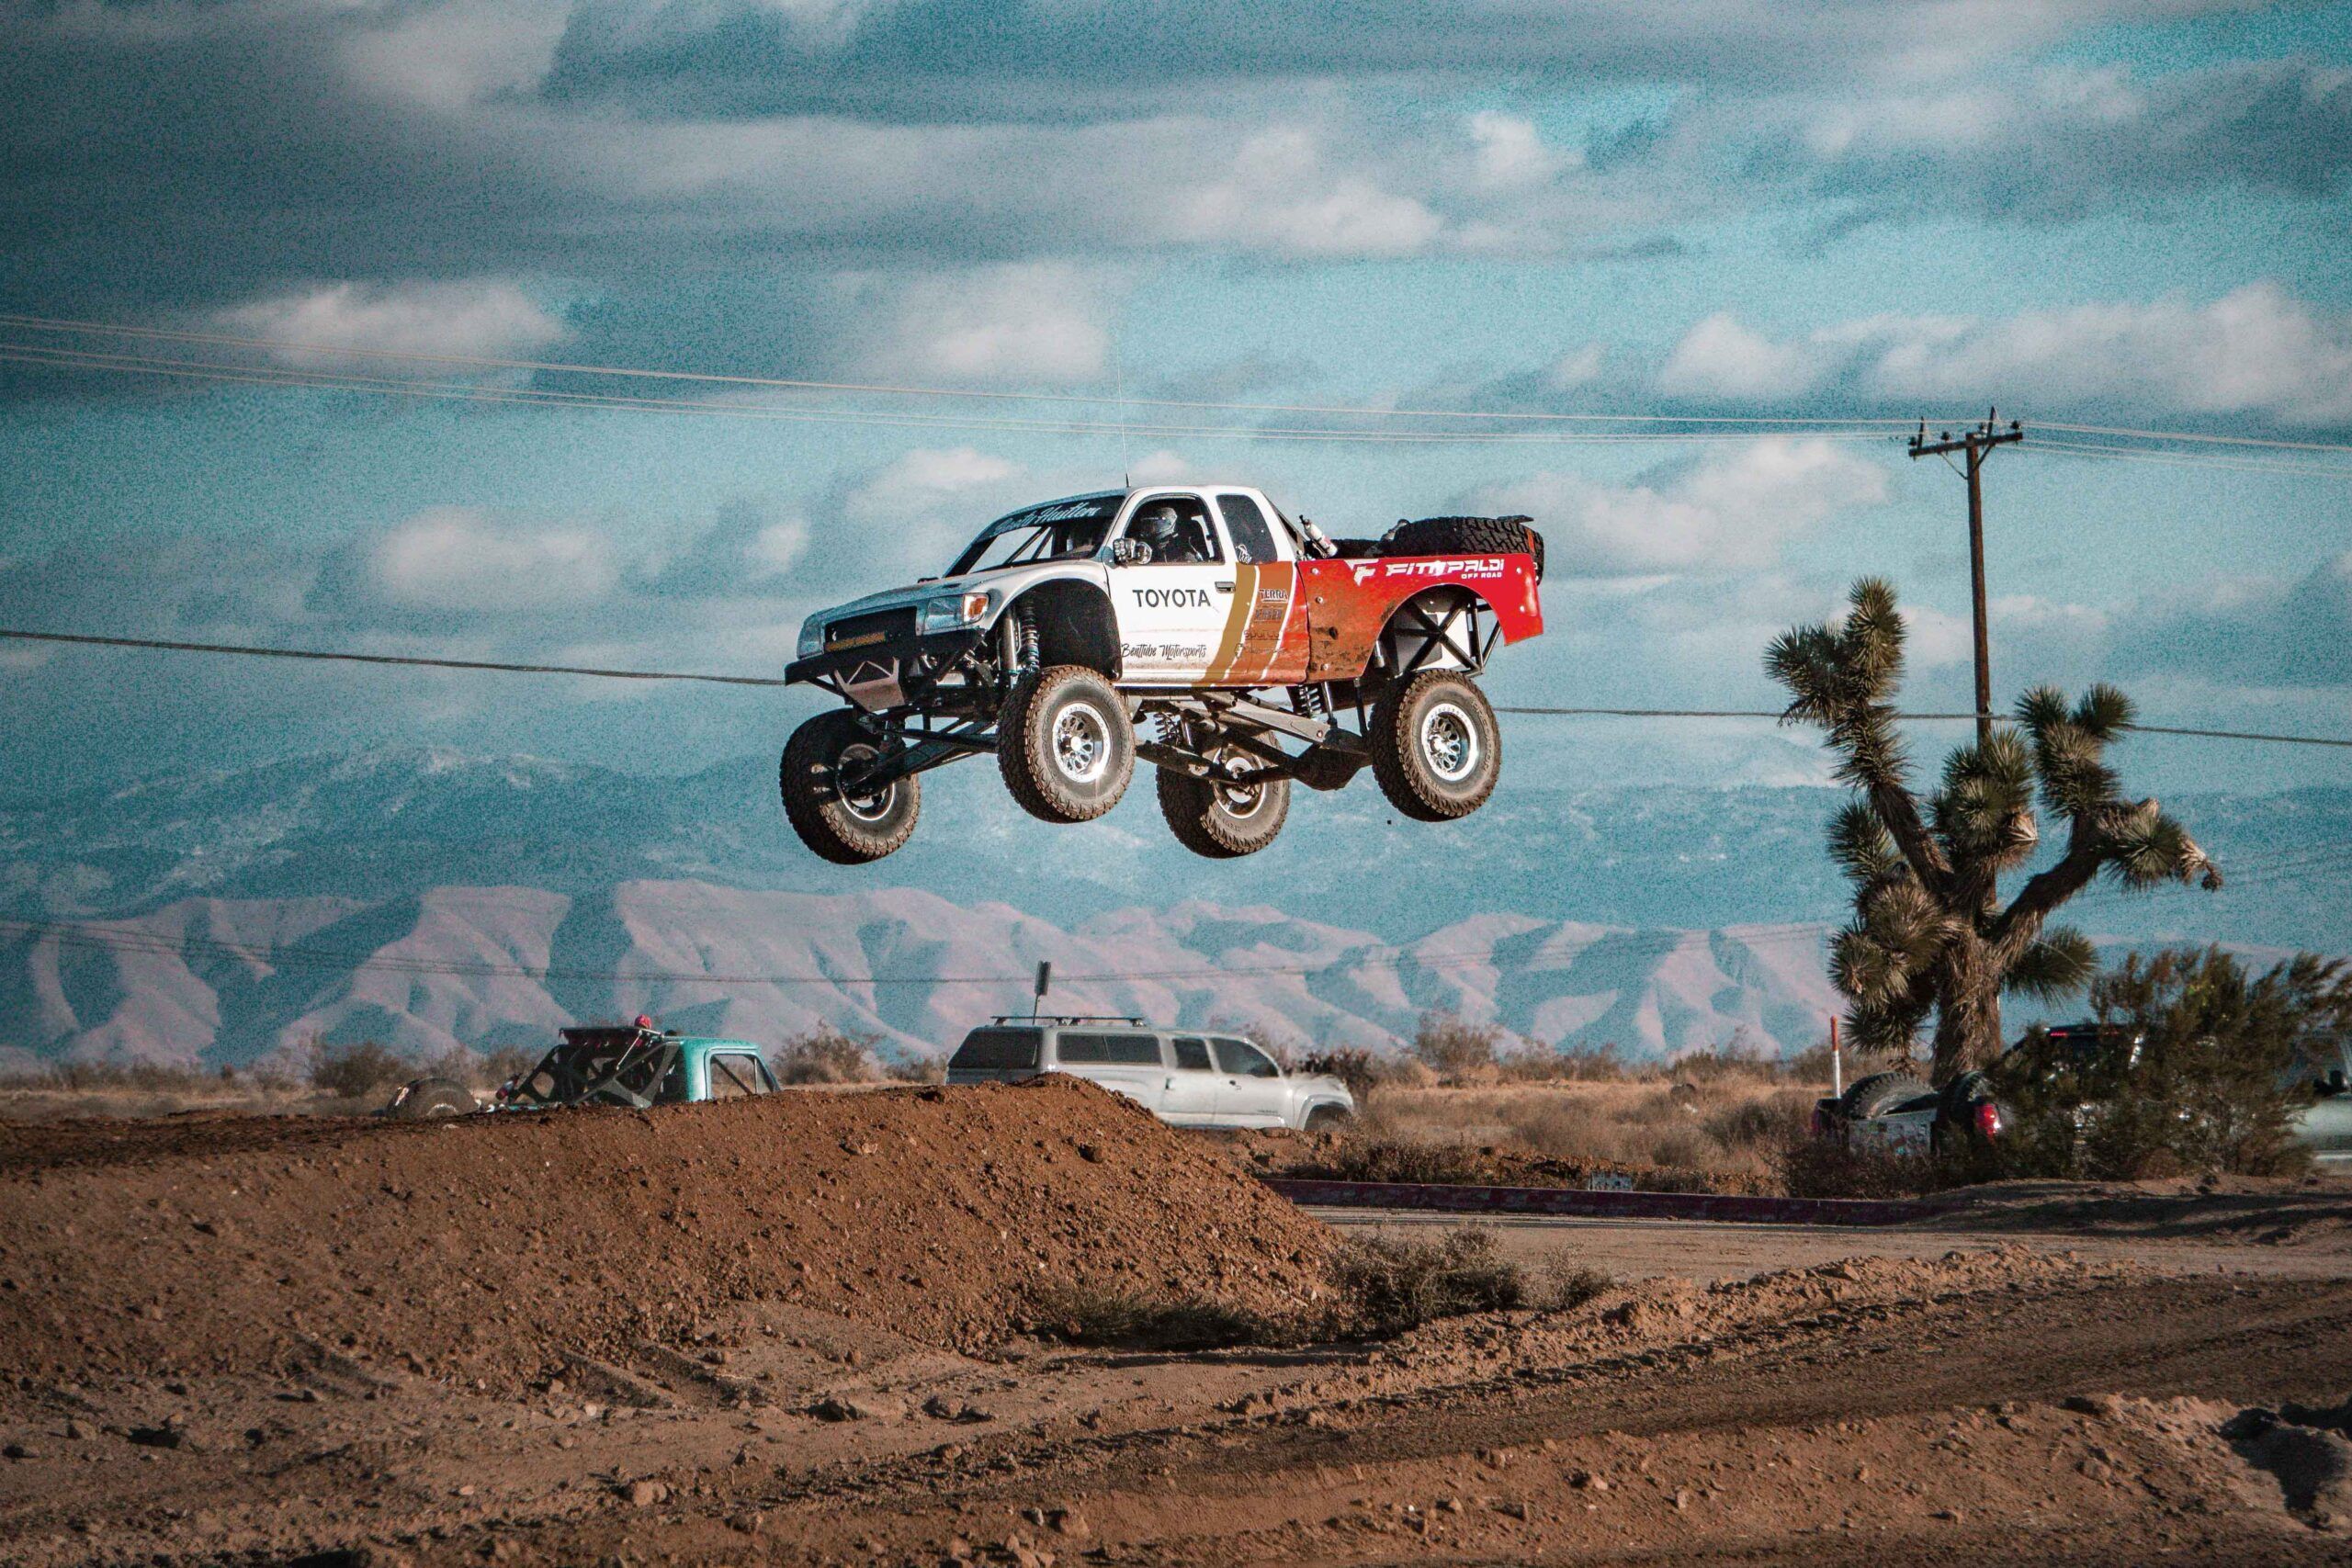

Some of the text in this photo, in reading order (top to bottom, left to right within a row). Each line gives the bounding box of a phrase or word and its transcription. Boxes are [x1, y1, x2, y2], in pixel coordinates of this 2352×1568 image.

[1132, 589, 1211, 607] TOYOTA
[1259, 589, 1288, 600] TERRA
[1159, 643, 1207, 660] Motorsports
